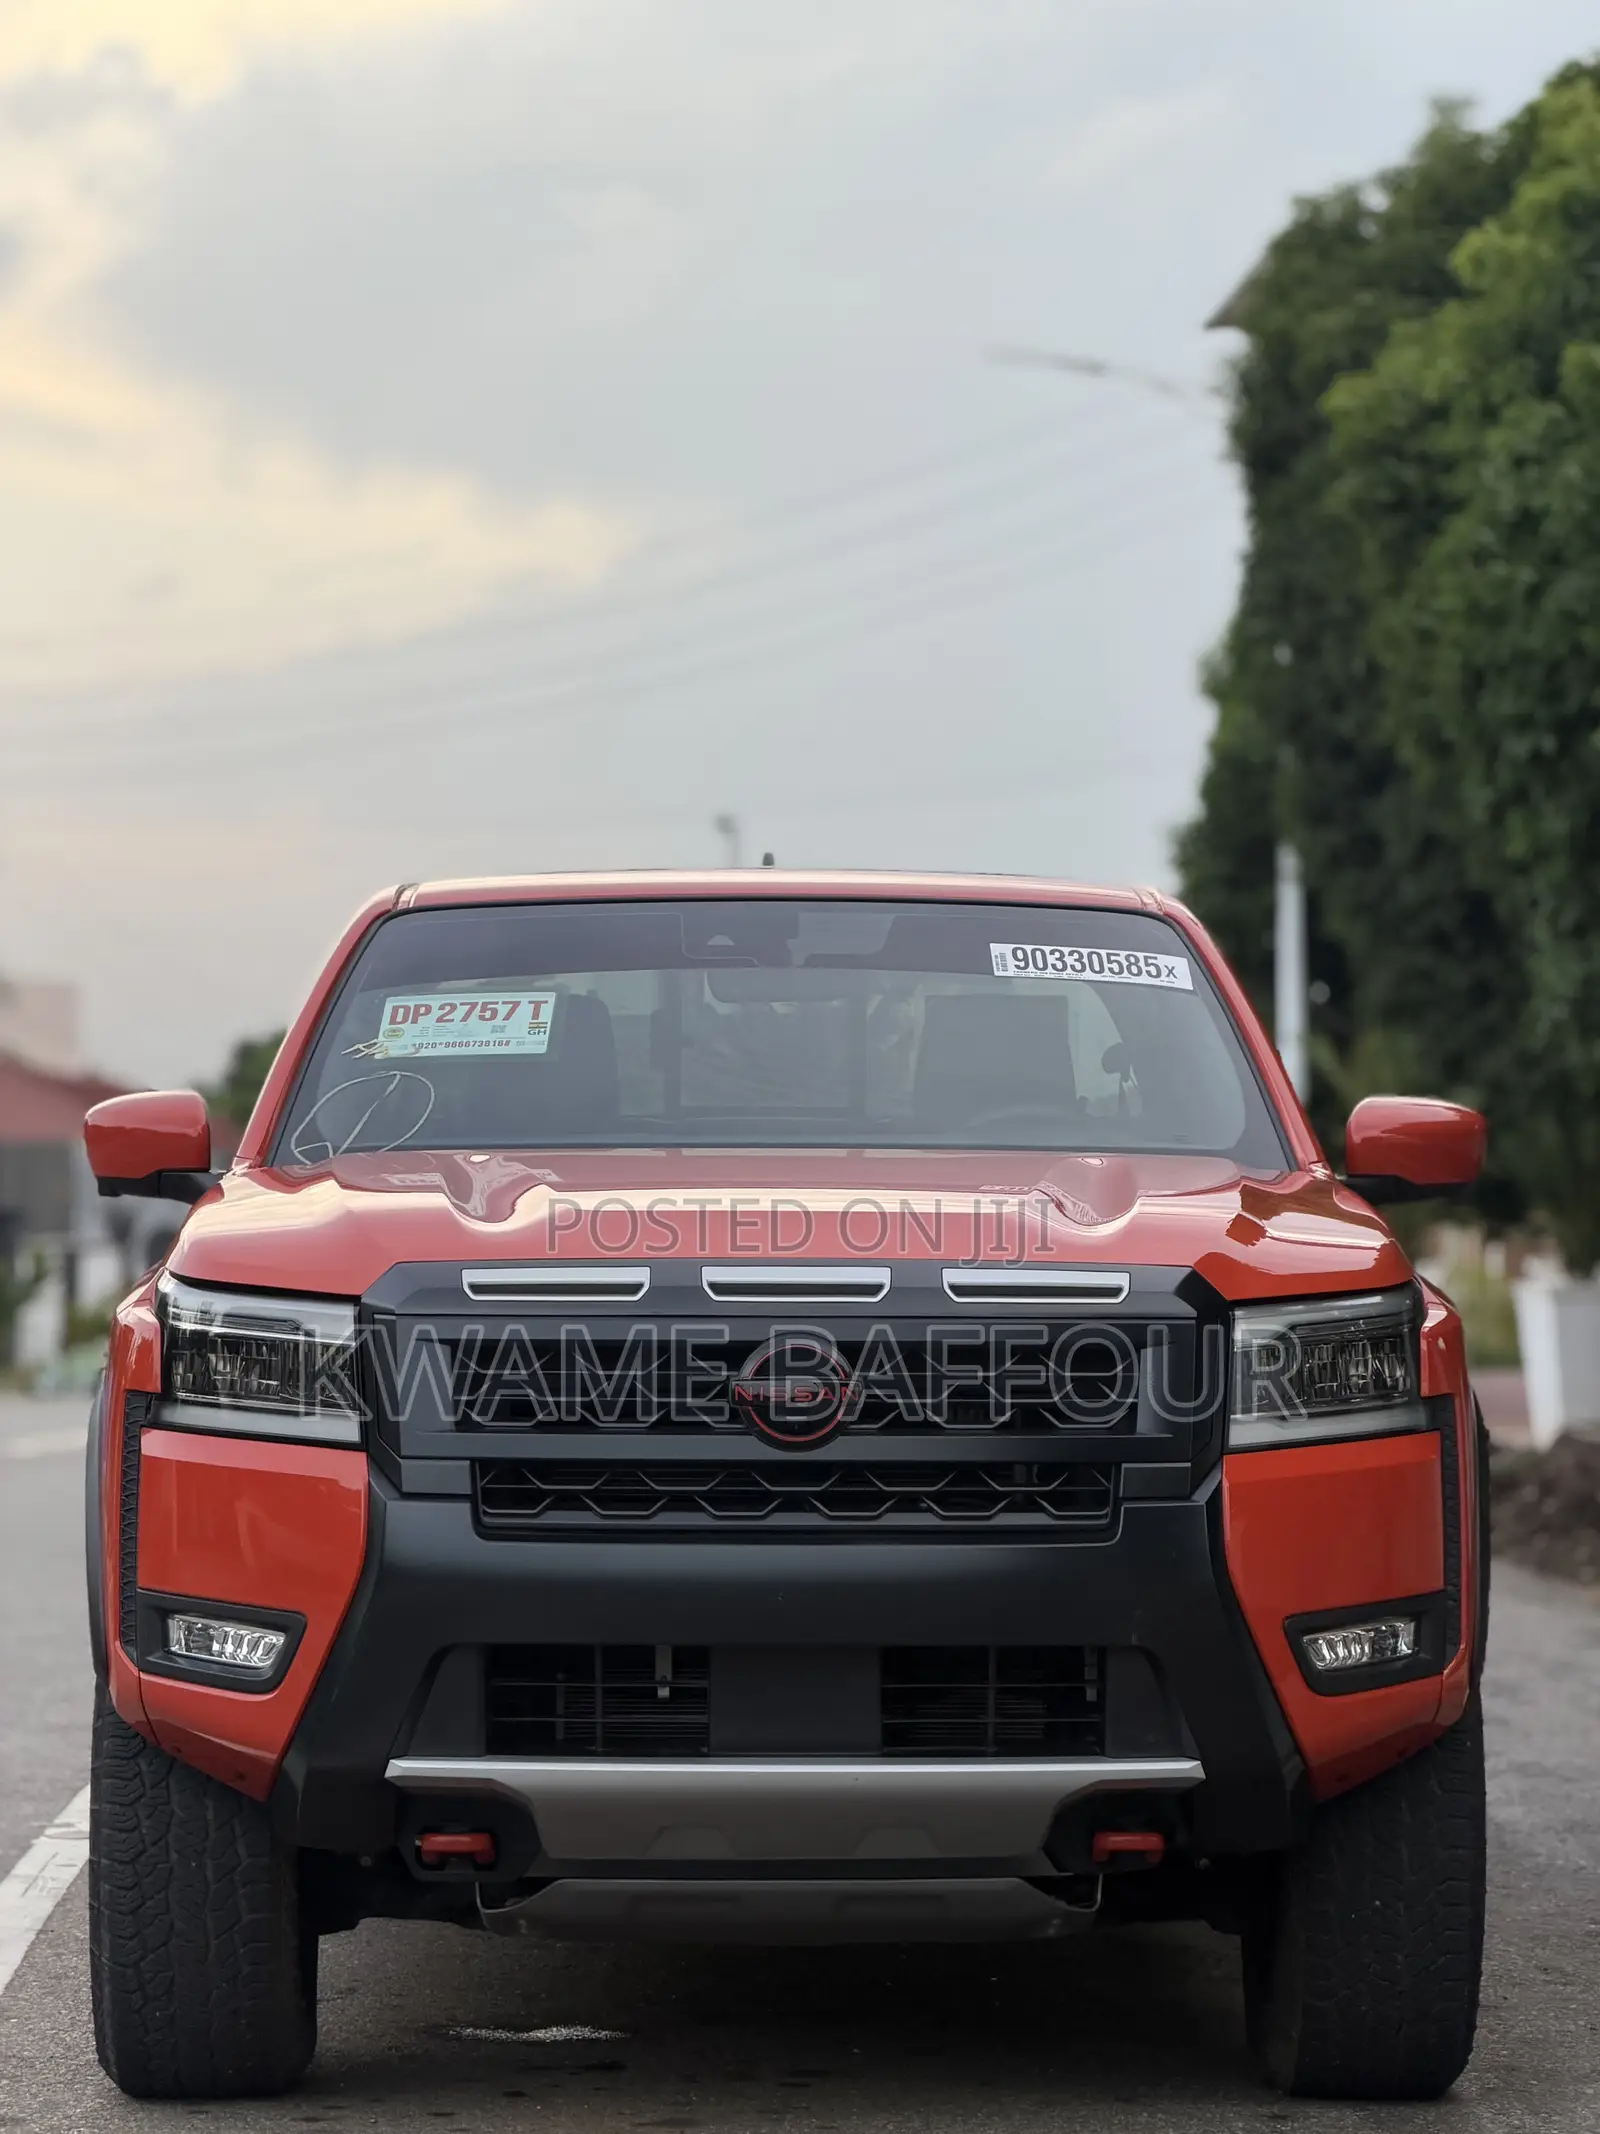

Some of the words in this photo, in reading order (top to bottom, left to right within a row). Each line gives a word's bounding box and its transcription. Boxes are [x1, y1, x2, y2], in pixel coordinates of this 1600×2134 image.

[388, 1003, 432, 1026] DP
[435, 1000, 521, 1024] 2757
[528, 1000, 549, 1021] T
[734, 1384, 859, 1403] NISSAN
